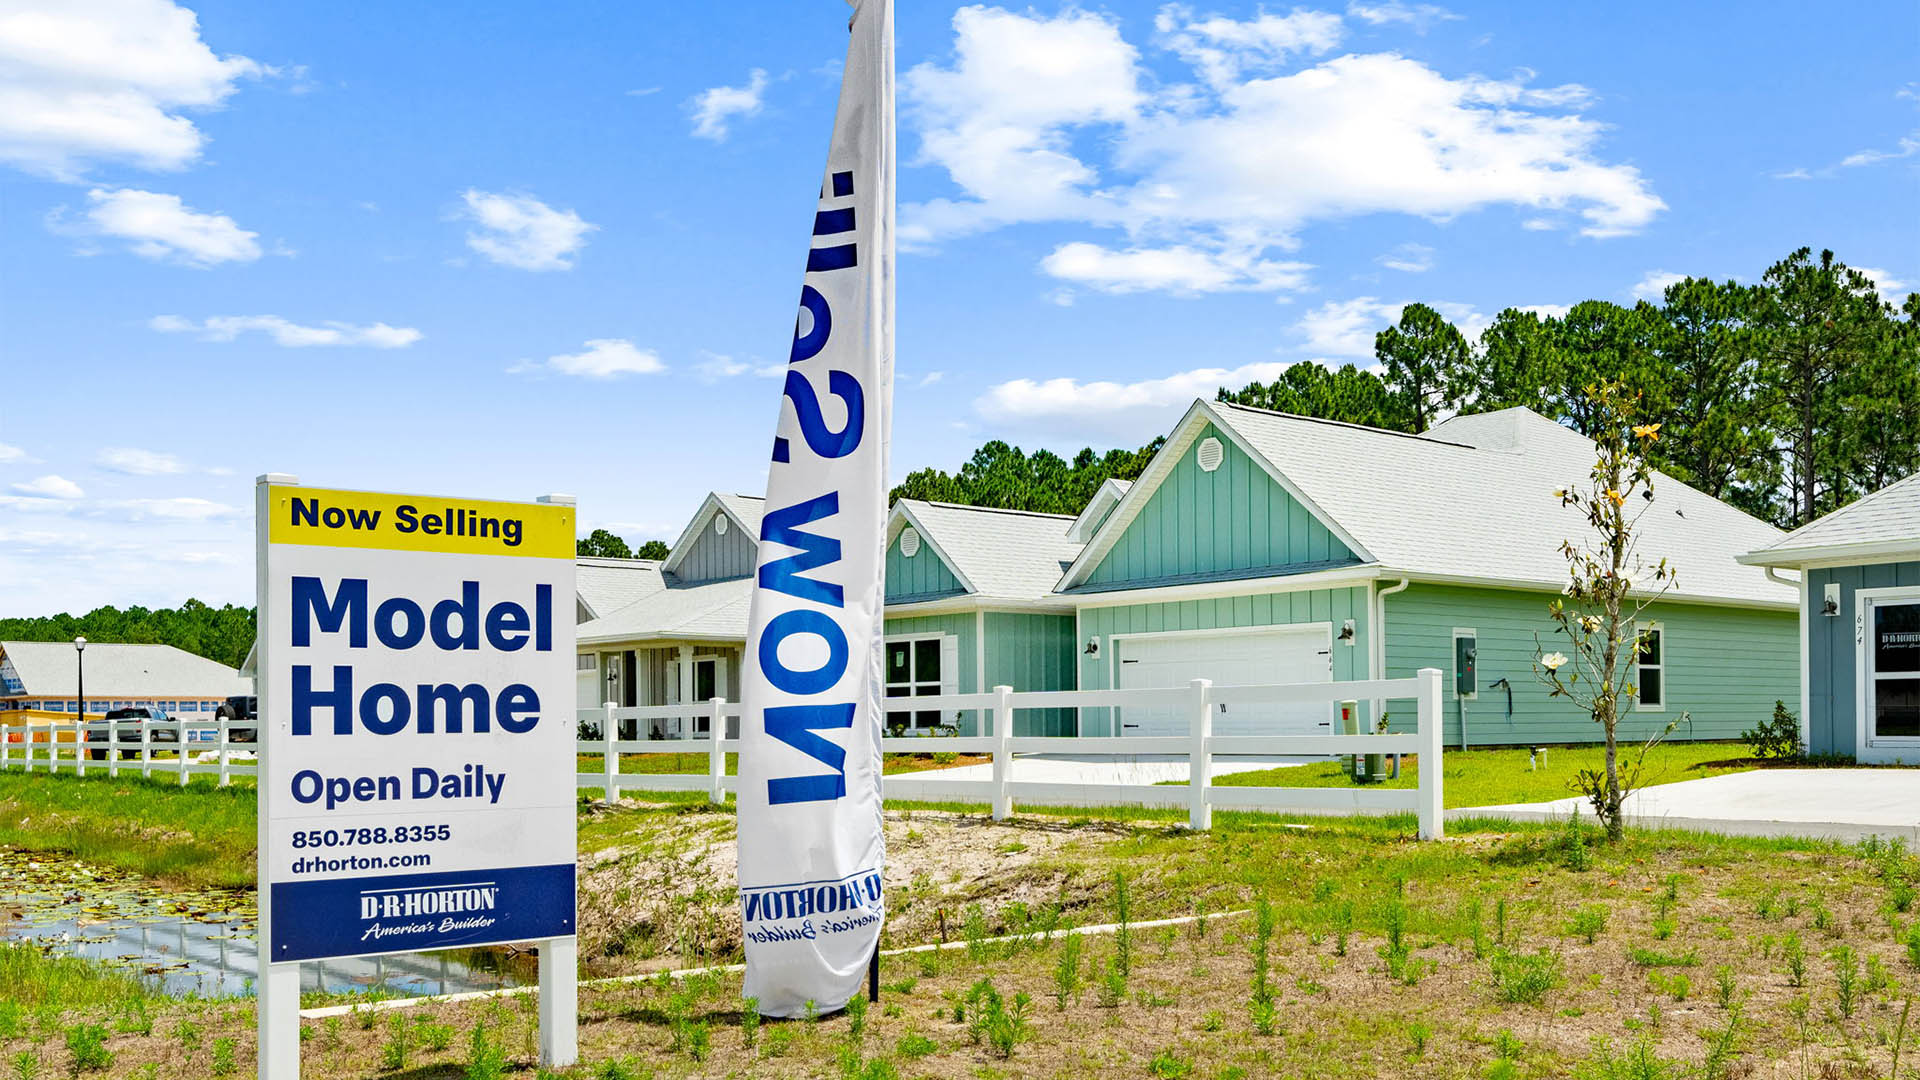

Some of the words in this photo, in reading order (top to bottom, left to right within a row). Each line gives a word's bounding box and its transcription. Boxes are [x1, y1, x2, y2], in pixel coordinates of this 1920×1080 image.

[291, 497, 381, 530] Now
[395, 504, 523, 547] Selling
[291, 575, 552, 652] Model
[291, 664, 540, 736] Home
[291, 769, 401, 810] Open
[412, 763, 506, 804] Daily
[292, 824, 451, 849] 850.788.8355
[292, 853, 431, 874] drhorton.com
[361, 921, 435, 941] America's
[437, 915, 496, 933] Builder
